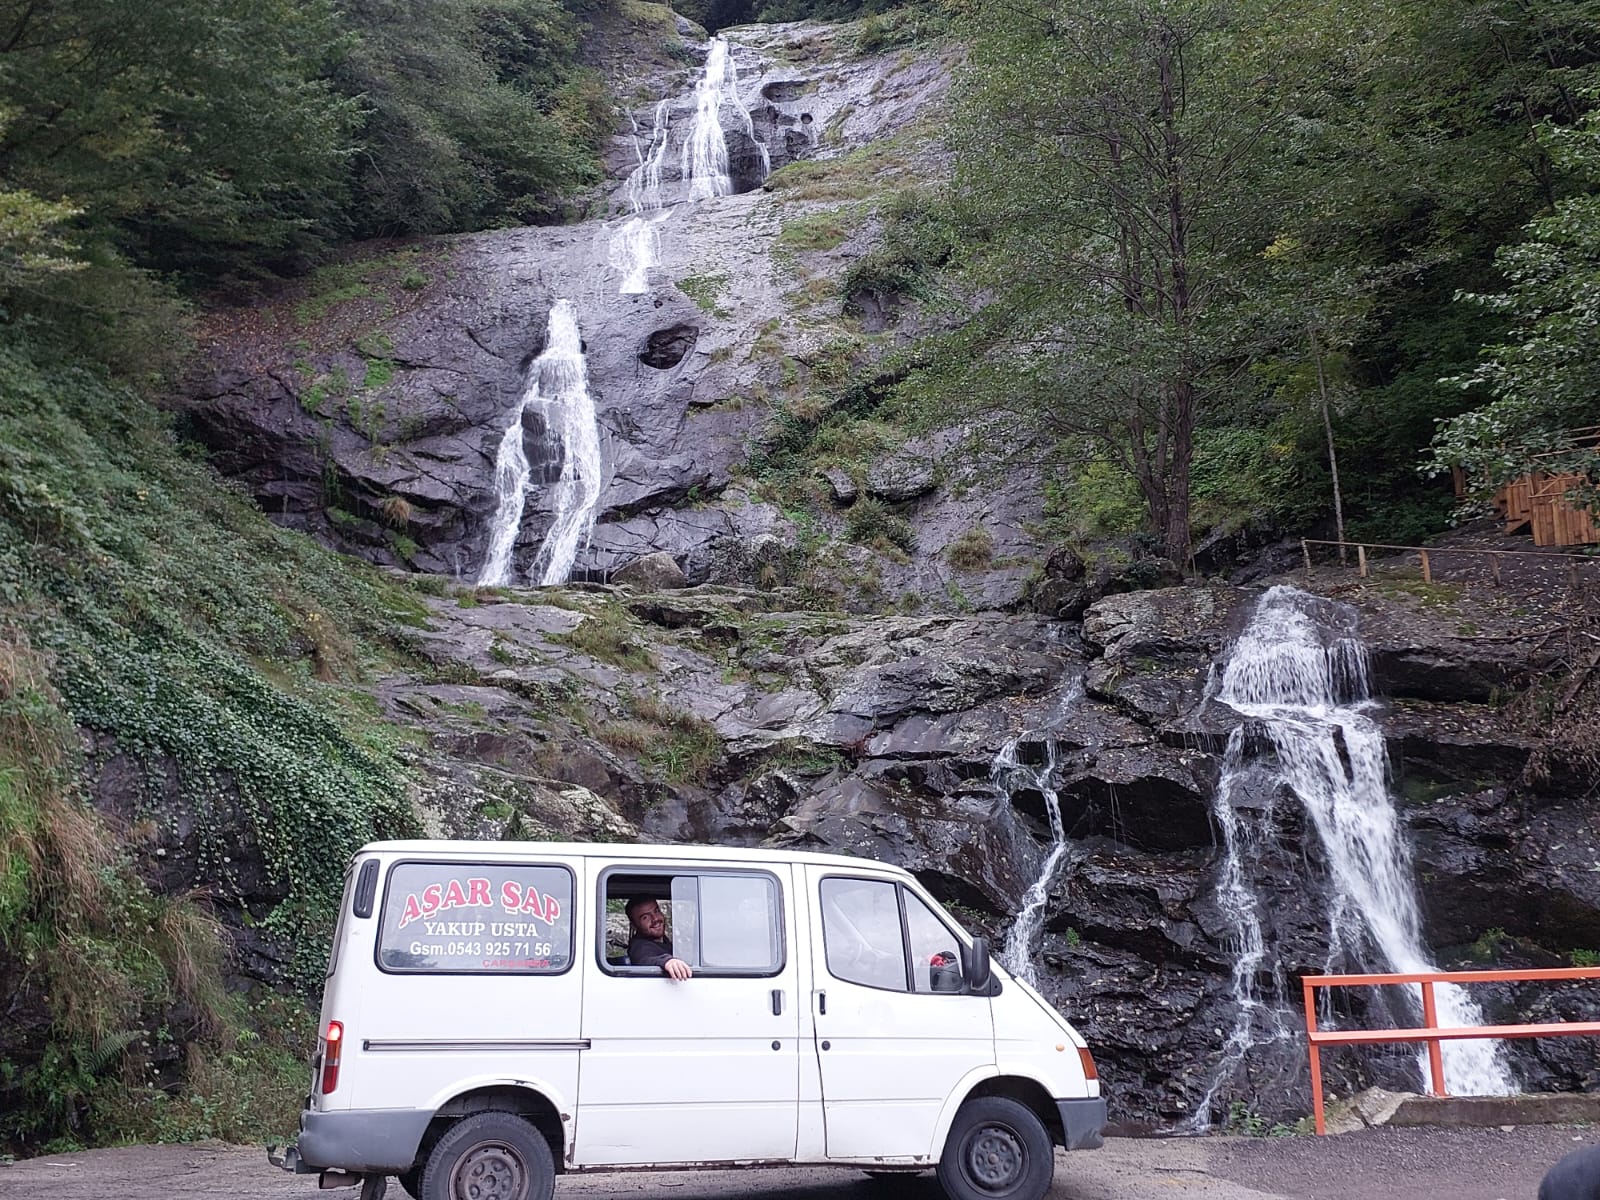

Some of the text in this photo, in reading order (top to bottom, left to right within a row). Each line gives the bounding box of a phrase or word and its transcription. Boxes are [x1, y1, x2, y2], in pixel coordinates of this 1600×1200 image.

[423, 921, 539, 937] YAKUP USTA
[485, 942, 511, 956] 925
[514, 942, 530, 956] 71
[534, 942, 552, 957] 56
